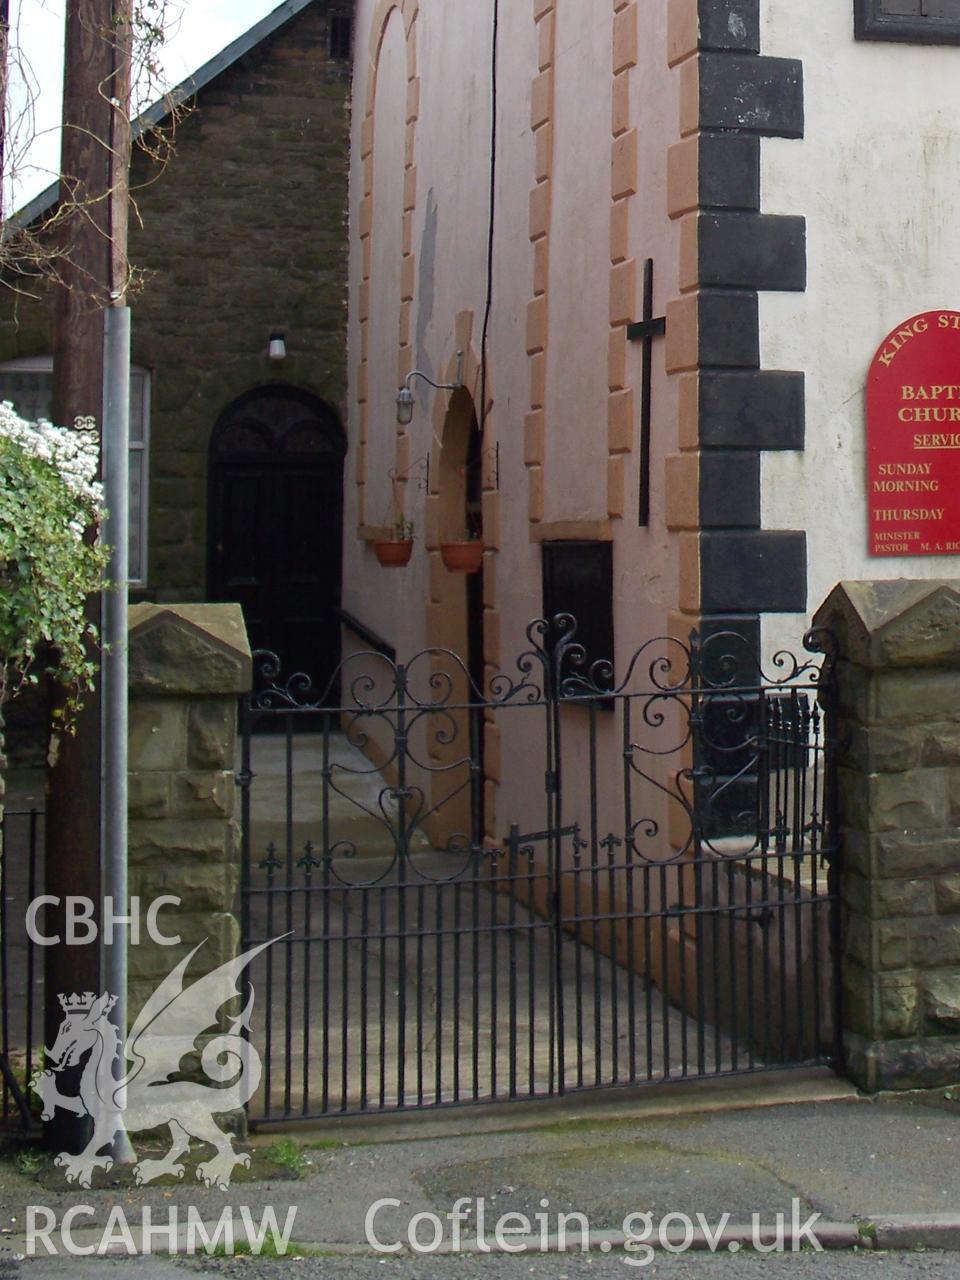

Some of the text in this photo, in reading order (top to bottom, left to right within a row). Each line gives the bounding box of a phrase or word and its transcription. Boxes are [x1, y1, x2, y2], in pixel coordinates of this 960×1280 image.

[878, 319, 929, 368] KING
[878, 463, 932, 476] SUNDAY
[873, 480, 939, 493] MORNING
[873, 508, 945, 521] THURSDAY
[874, 531, 920, 541] MINISTER
[874, 543, 909, 553] PASTOR
